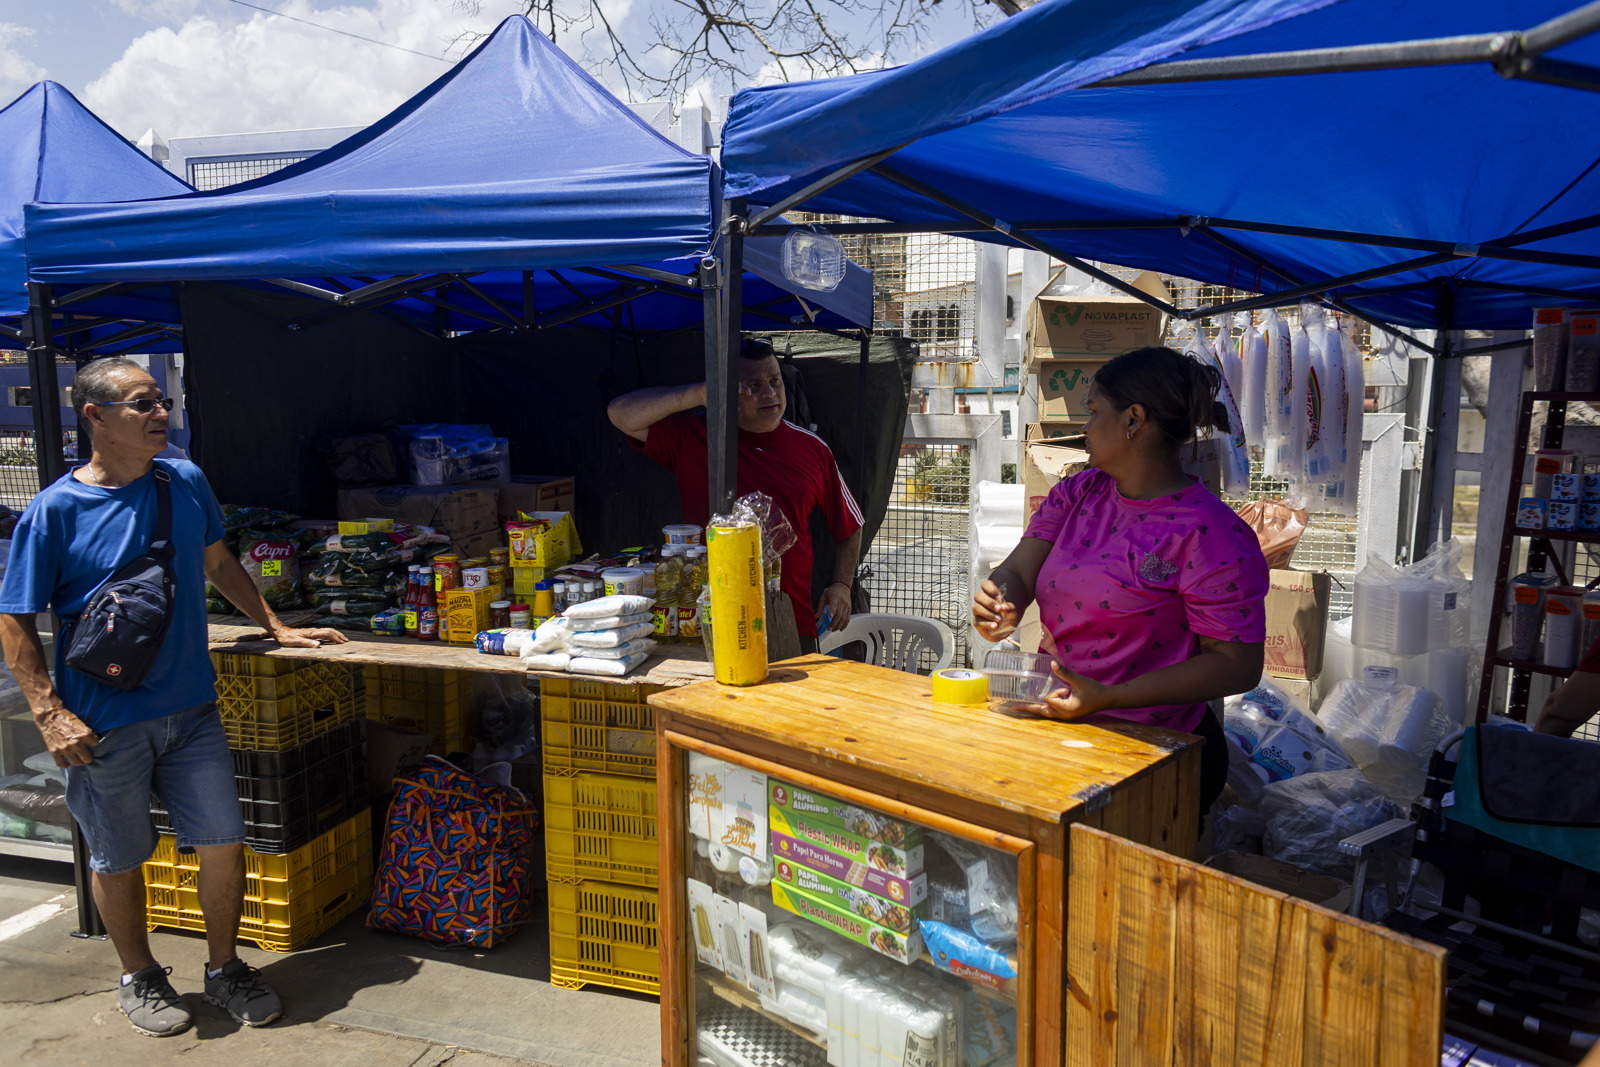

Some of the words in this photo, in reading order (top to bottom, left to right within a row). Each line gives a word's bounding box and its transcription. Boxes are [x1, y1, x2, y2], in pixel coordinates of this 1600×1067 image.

[1084, 312, 1152, 321] NOVAPLAST
[254, 543, 291, 560] Capri
[748, 556, 756, 587] KITCHEN
[1288, 584, 1303, 592] 150
[679, 608, 692, 618] atel
[738, 620, 747, 650] KITCHEN
[1266, 665, 1305, 675] UNIDADES
[777, 787, 784, 798] 9
[792, 790, 815, 803] PAPEL
[792, 800, 829, 814] ALUMINIO
[798, 820, 830, 845] Plastic
[832, 833, 861, 855] WRAP
[793, 842, 808, 856] Papel
[809, 848, 824, 861] Para
[824, 854, 844, 869] Horno
[781, 864, 788, 874] 9
[797, 868, 819, 882] PAPEL
[798, 878, 834, 894] ALUMINIO
[890, 880, 900, 897] 5
[800, 899, 833, 924] Plastic
[834, 914, 863, 936] WRAP
